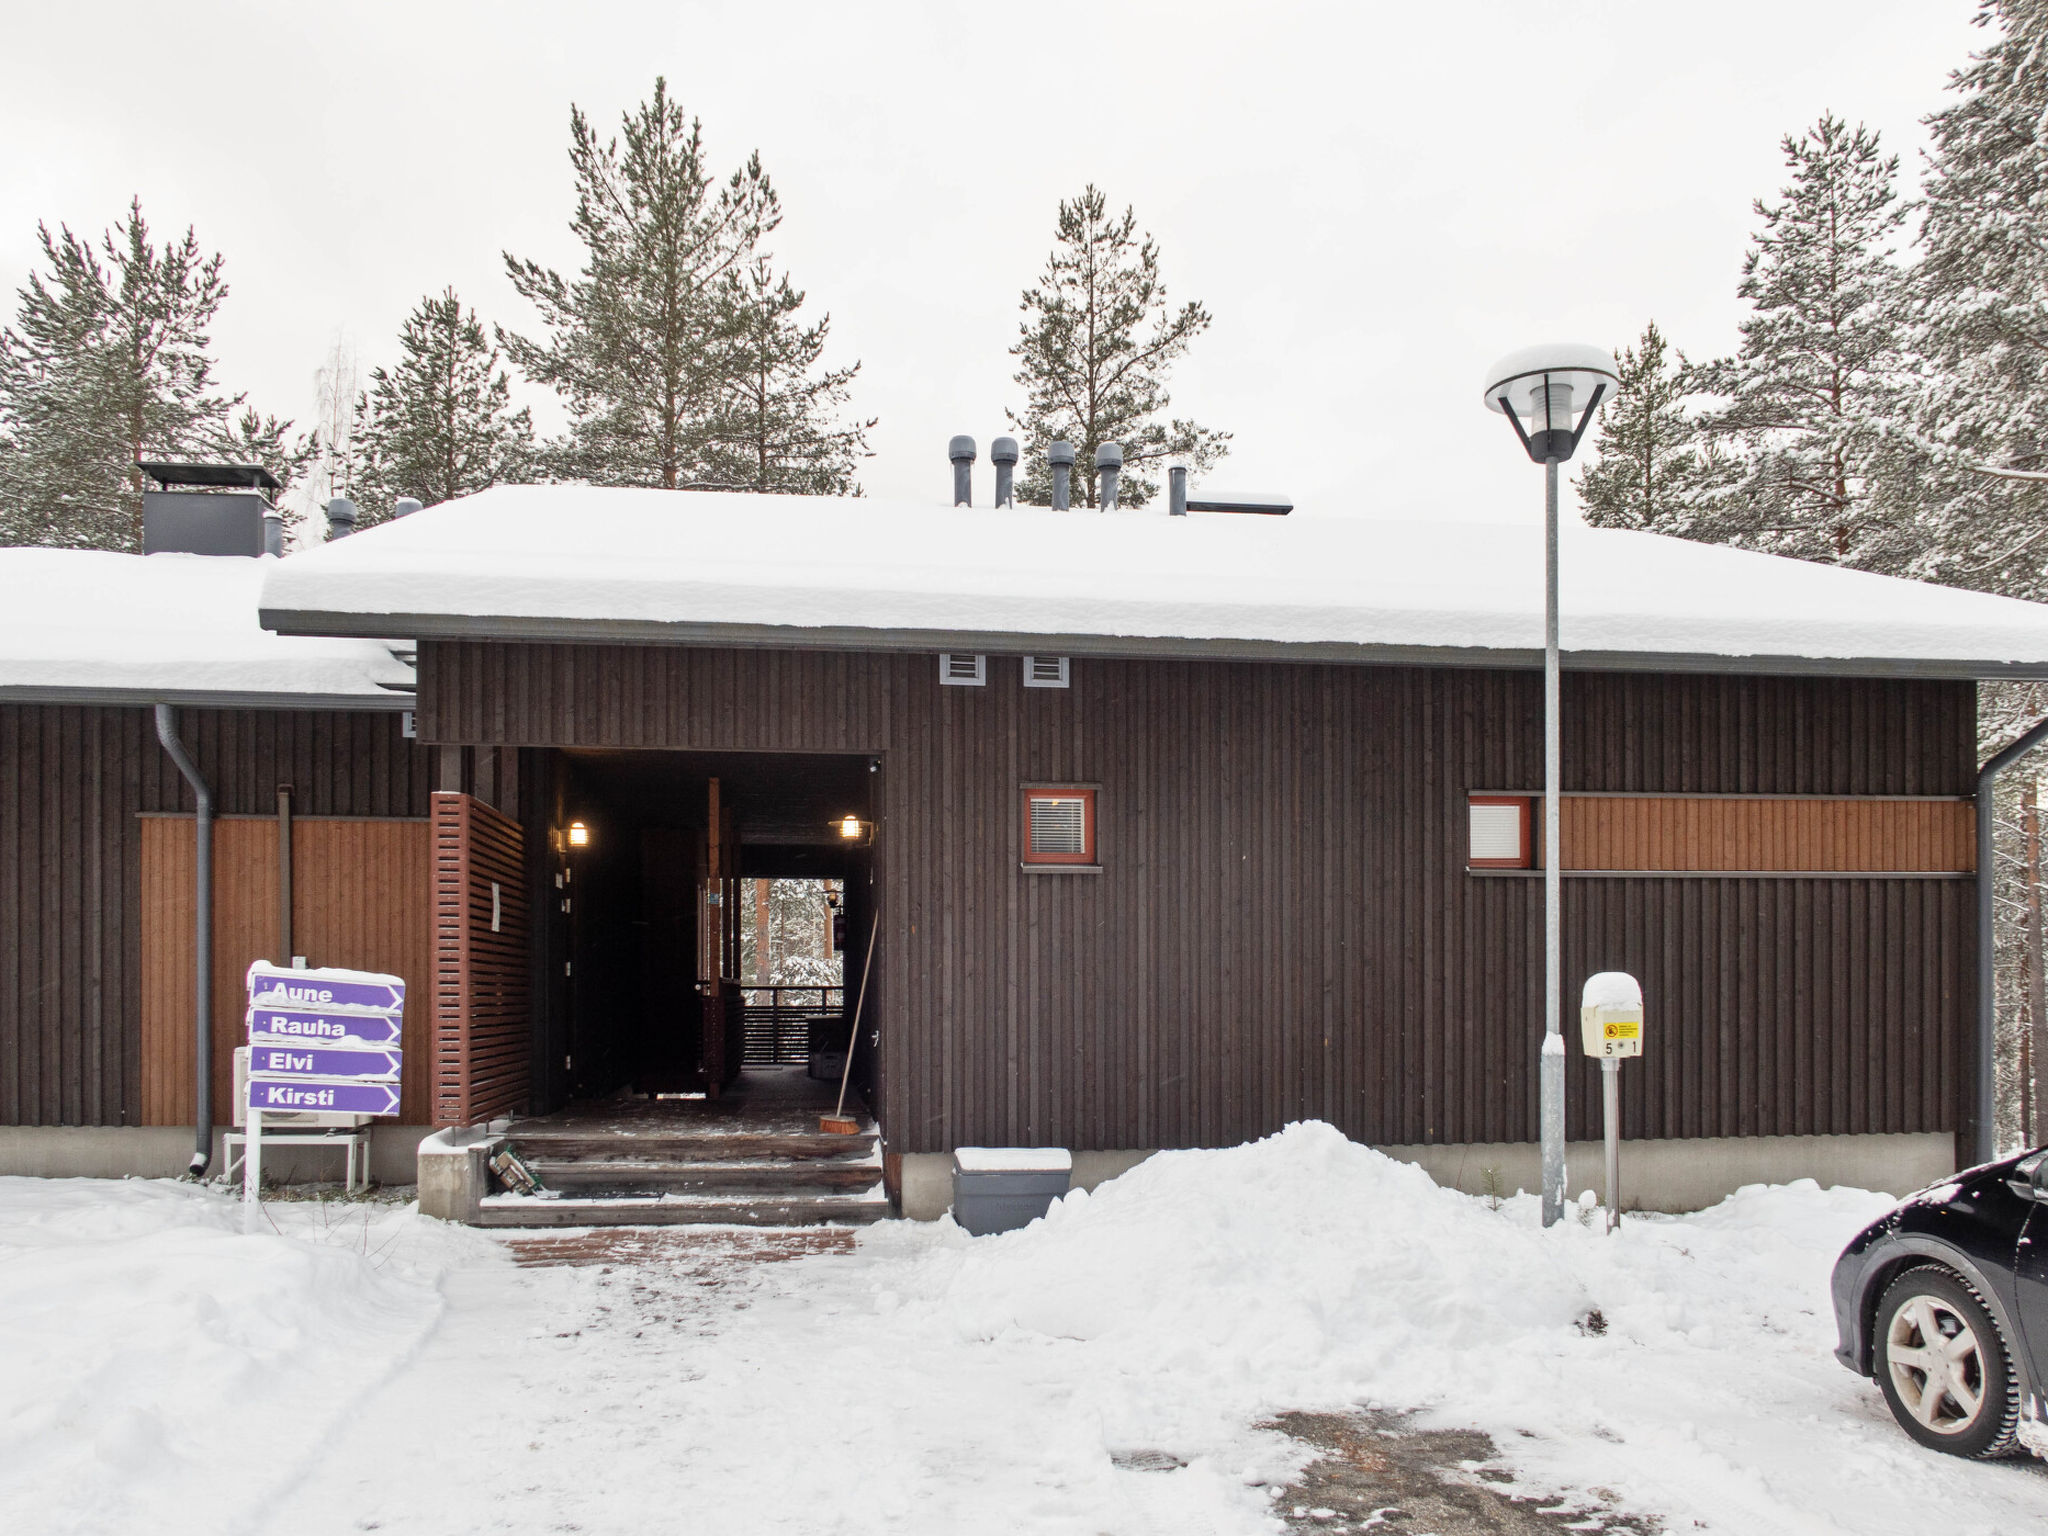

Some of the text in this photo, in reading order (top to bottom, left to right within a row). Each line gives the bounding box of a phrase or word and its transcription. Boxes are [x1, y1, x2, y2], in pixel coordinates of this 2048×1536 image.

[272, 982, 333, 1003] Aune
[270, 1016, 346, 1037] Rauha
[1605, 1042, 1613, 1055] 5
[268, 1052, 314, 1071] Elvi
[267, 1086, 335, 1106] Kirsti
